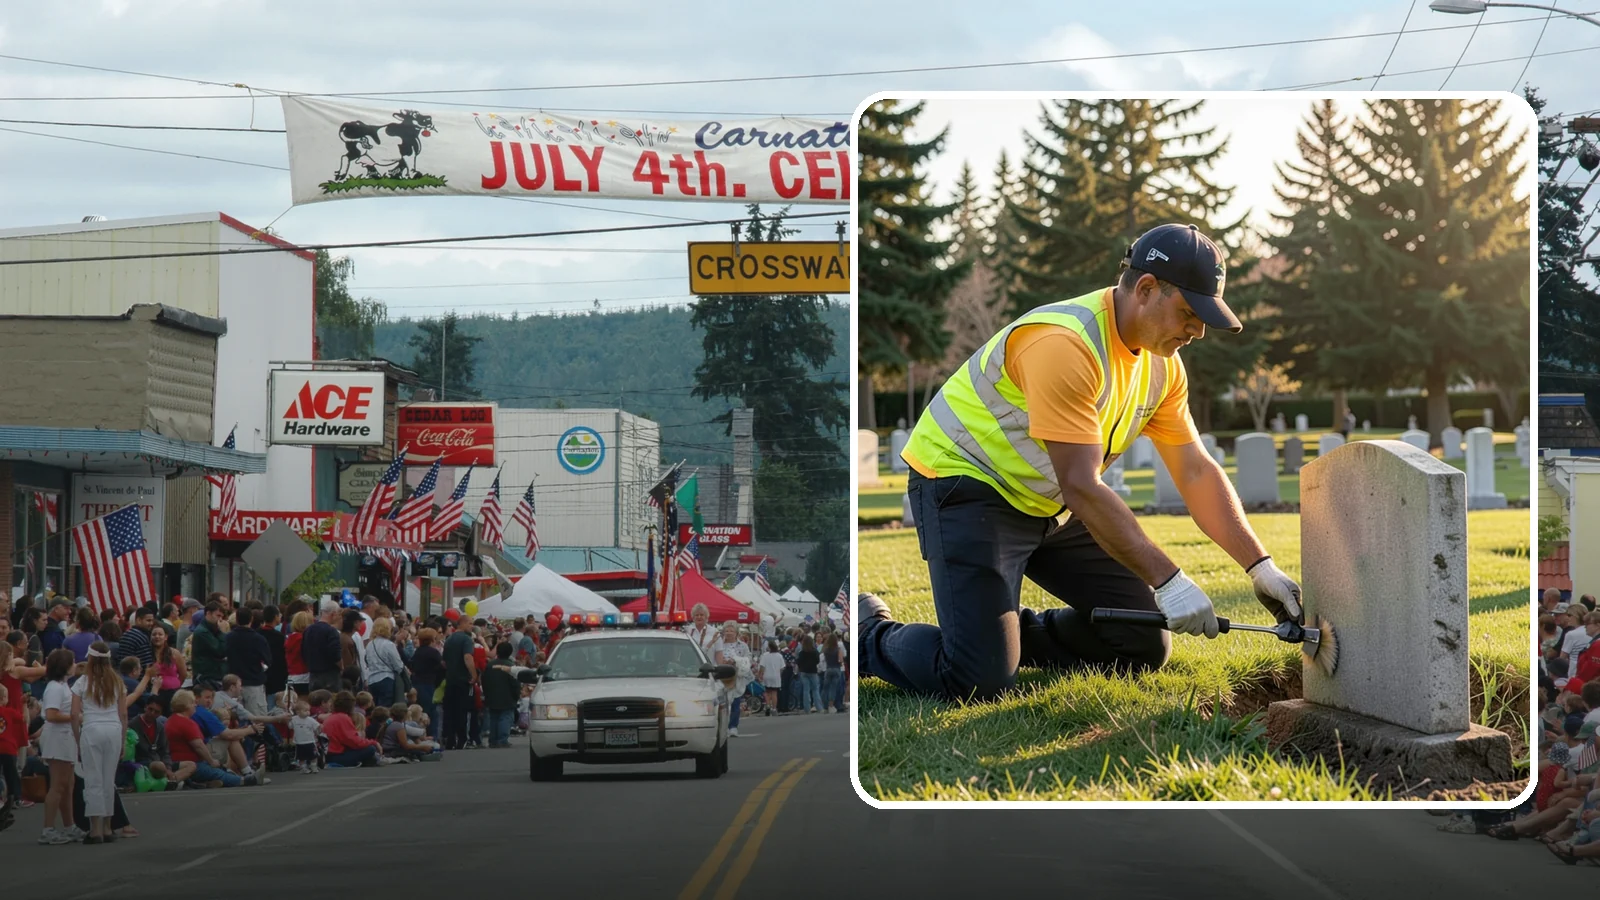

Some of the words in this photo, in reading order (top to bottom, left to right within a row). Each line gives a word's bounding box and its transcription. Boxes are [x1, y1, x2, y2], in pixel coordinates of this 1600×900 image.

[481, 140, 605, 192] JULY
[631, 149, 747, 198] 4th.
[696, 253, 850, 281] CROSSWA
[282, 380, 374, 420] ACE
[406, 409, 453, 422] CEDAR
[283, 421, 371, 437] Hardware
[416, 428, 478, 447] Coca-Cola
[95, 485, 125, 495] Vincent
[126, 486, 136, 495] de
[137, 485, 155, 496] Paul
[688, 526, 742, 535] CRNATION
[699, 535, 730, 543] GLASS
